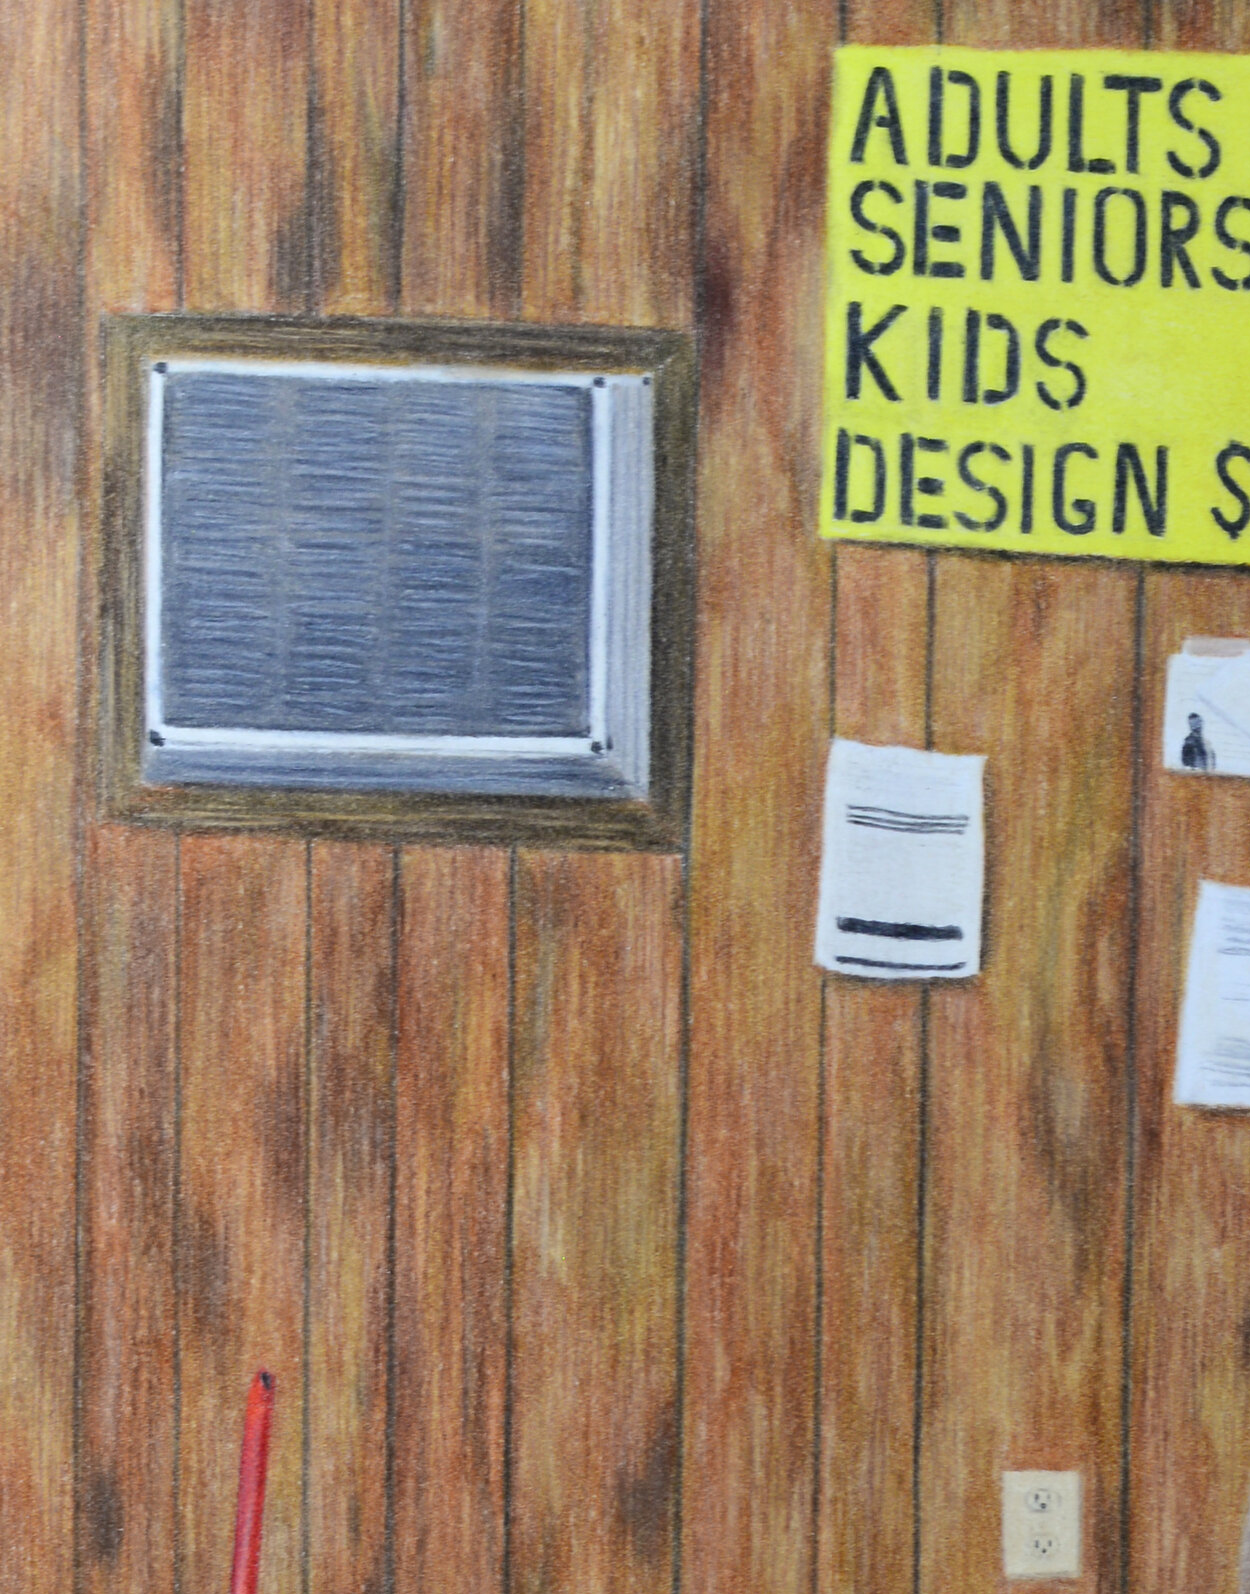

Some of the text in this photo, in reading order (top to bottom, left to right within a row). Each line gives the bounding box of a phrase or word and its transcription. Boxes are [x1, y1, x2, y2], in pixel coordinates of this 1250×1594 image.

[851, 67, 1222, 179] ADULTS
[846, 302, 1089, 411] KIDS
[834, 428, 1168, 537] DESIGN
